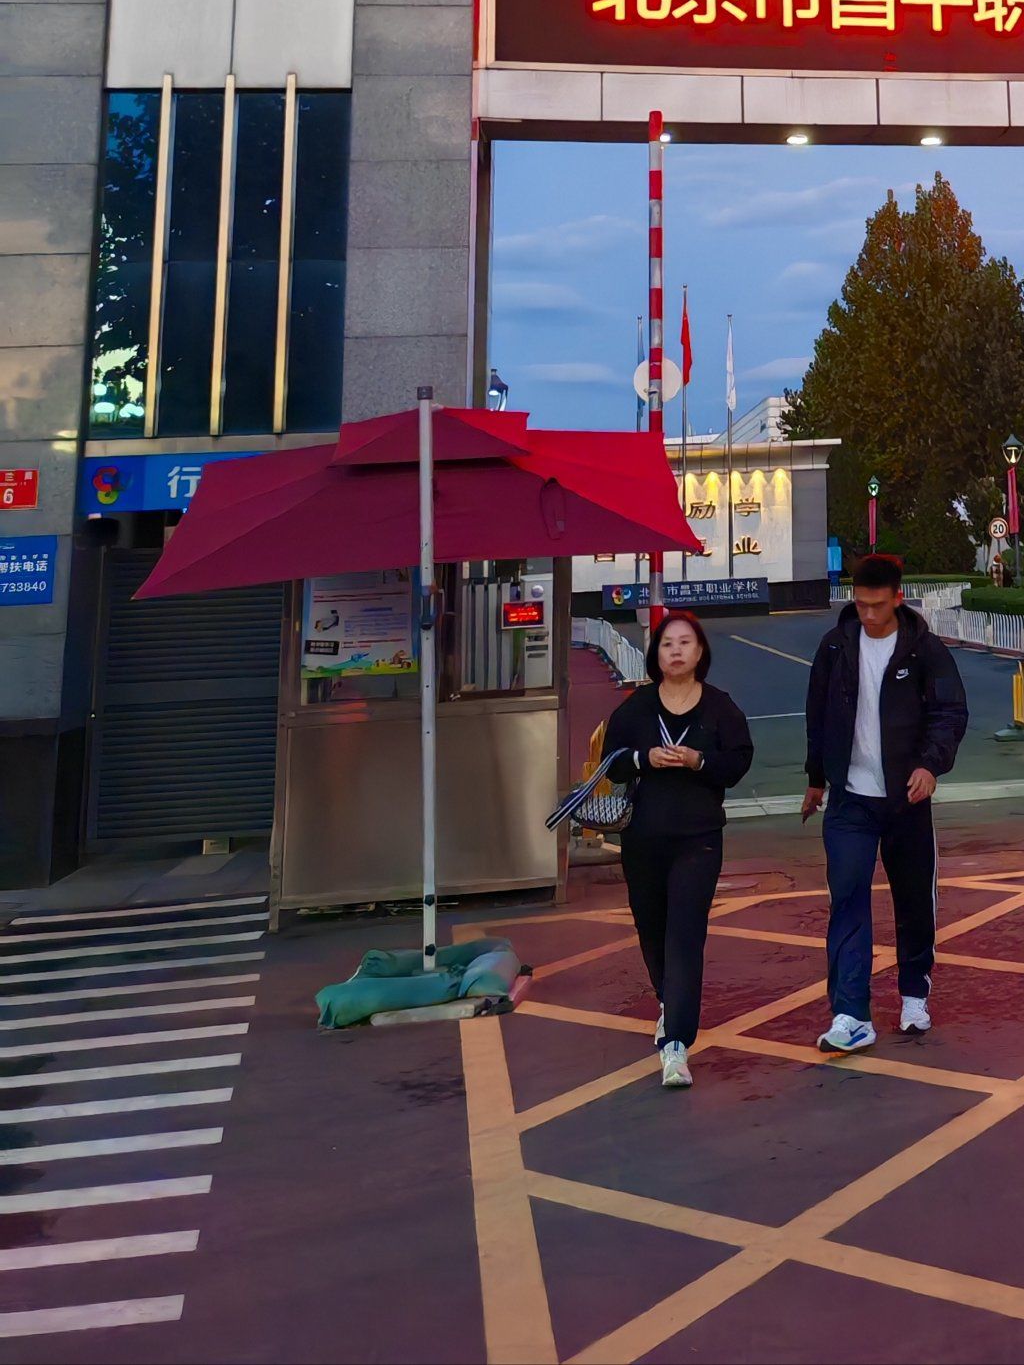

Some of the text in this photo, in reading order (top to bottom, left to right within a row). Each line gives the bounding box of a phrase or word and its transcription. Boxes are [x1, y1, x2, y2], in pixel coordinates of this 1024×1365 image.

[993, 524, 1004, 534] 20
[640, 581, 759, 598] 北市昌平职业学校
